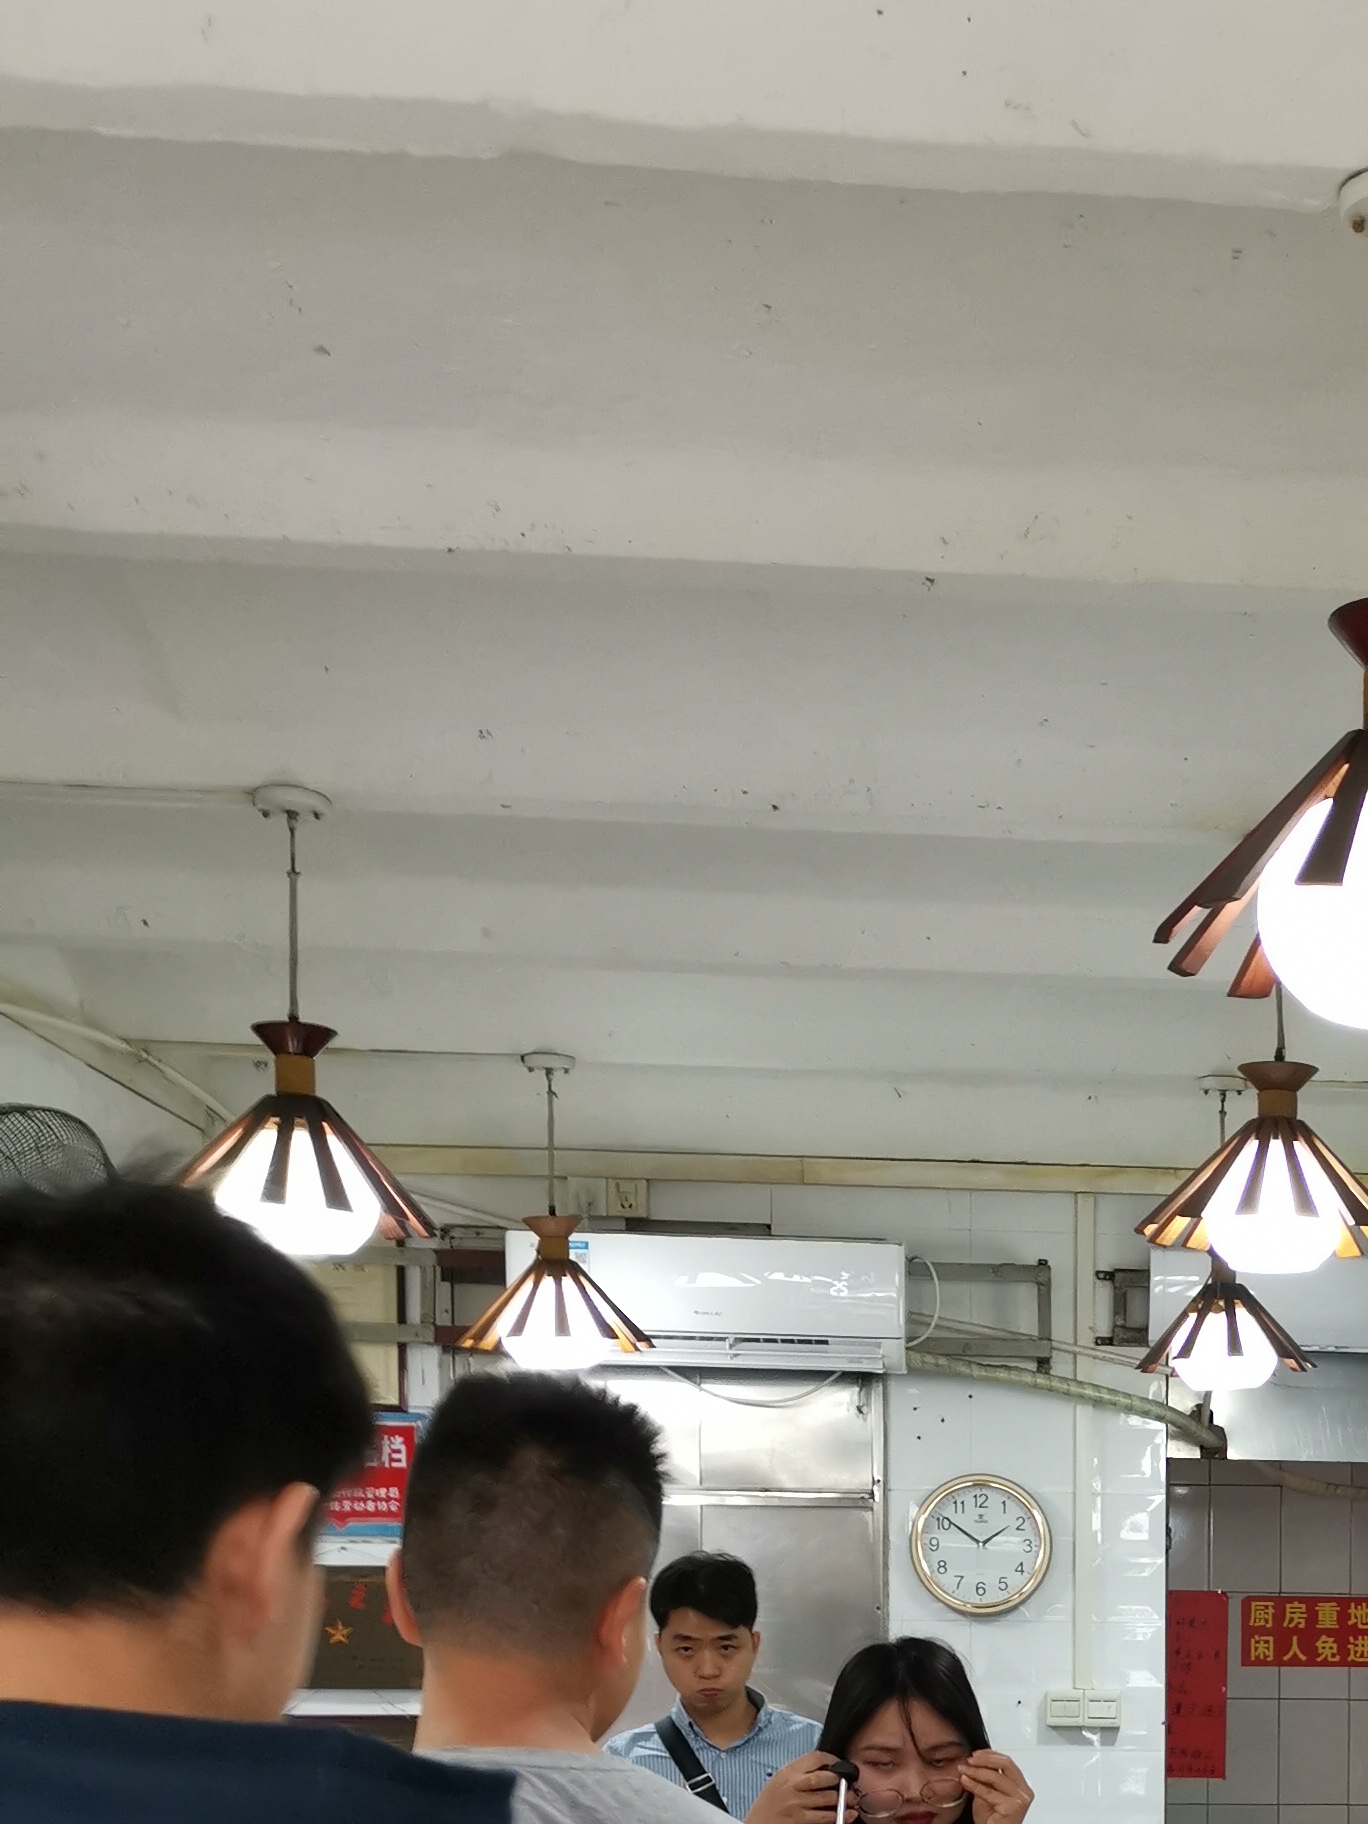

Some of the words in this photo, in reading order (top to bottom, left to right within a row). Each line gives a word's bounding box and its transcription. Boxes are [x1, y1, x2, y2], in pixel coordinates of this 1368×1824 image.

[952, 1500, 965, 1514] 11
[973, 1493, 989, 1508] 12
[1001, 1500, 1007, 1514] 1
[936, 1516, 951, 1530] 10
[1015, 1516, 1026, 1531] 2
[928, 1537, 940, 1552] 9
[1022, 1538, 1033, 1553] 3
[937, 1560, 948, 1574] 8
[1014, 1561, 1025, 1575] 4
[954, 1575, 964, 1590] 7
[975, 1582, 987, 1596] 6
[998, 1577, 1009, 1591] 5
